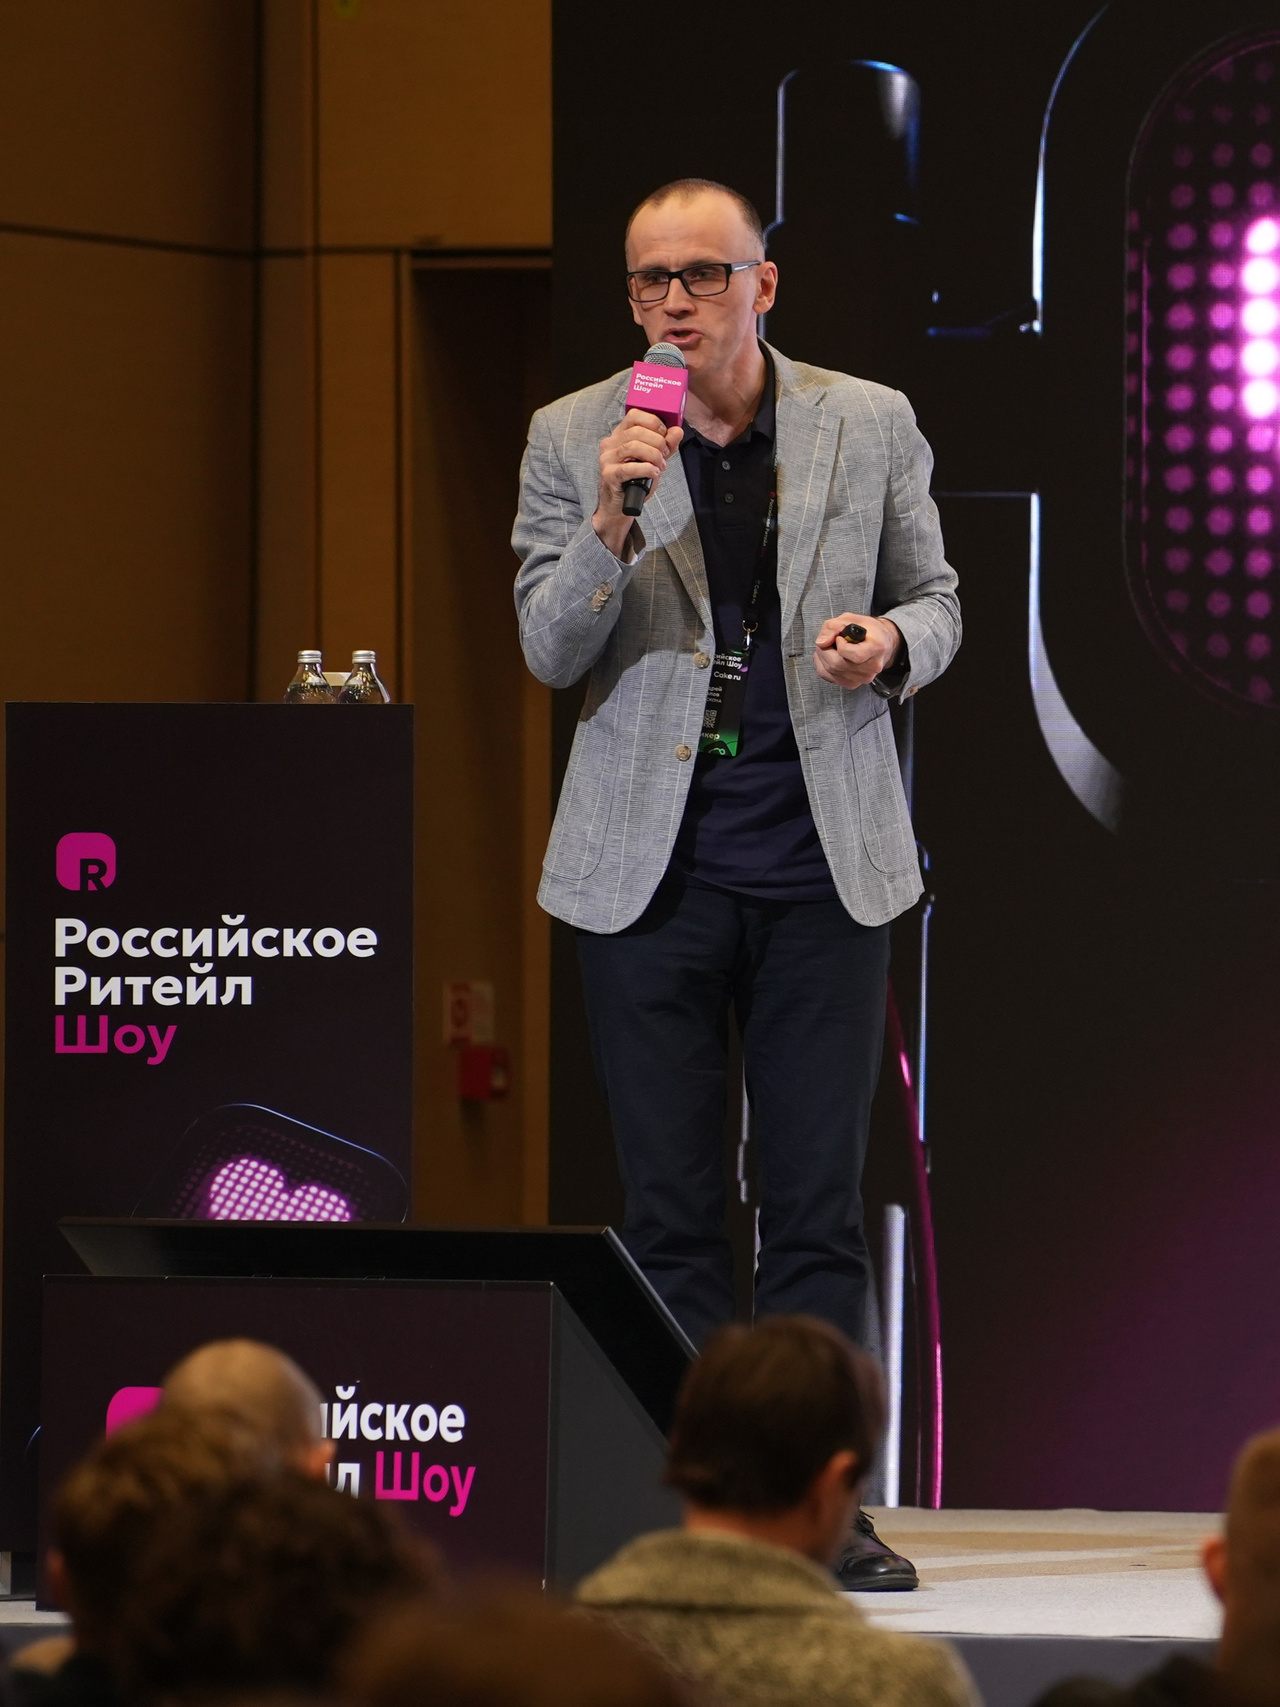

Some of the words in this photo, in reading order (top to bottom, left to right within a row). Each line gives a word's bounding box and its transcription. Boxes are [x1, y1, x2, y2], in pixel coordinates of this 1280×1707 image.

[633, 384, 652, 394] Шоу
[635, 379, 663, 389] Ритейл
[636, 373, 682, 386] Российское
[55, 914, 378, 957] Российское
[55, 962, 252, 1006] Ритейл
[55, 1014, 178, 1065] Шоу
[320, 1385, 466, 1443] йское
[375, 1450, 477, 1517] Шоу
